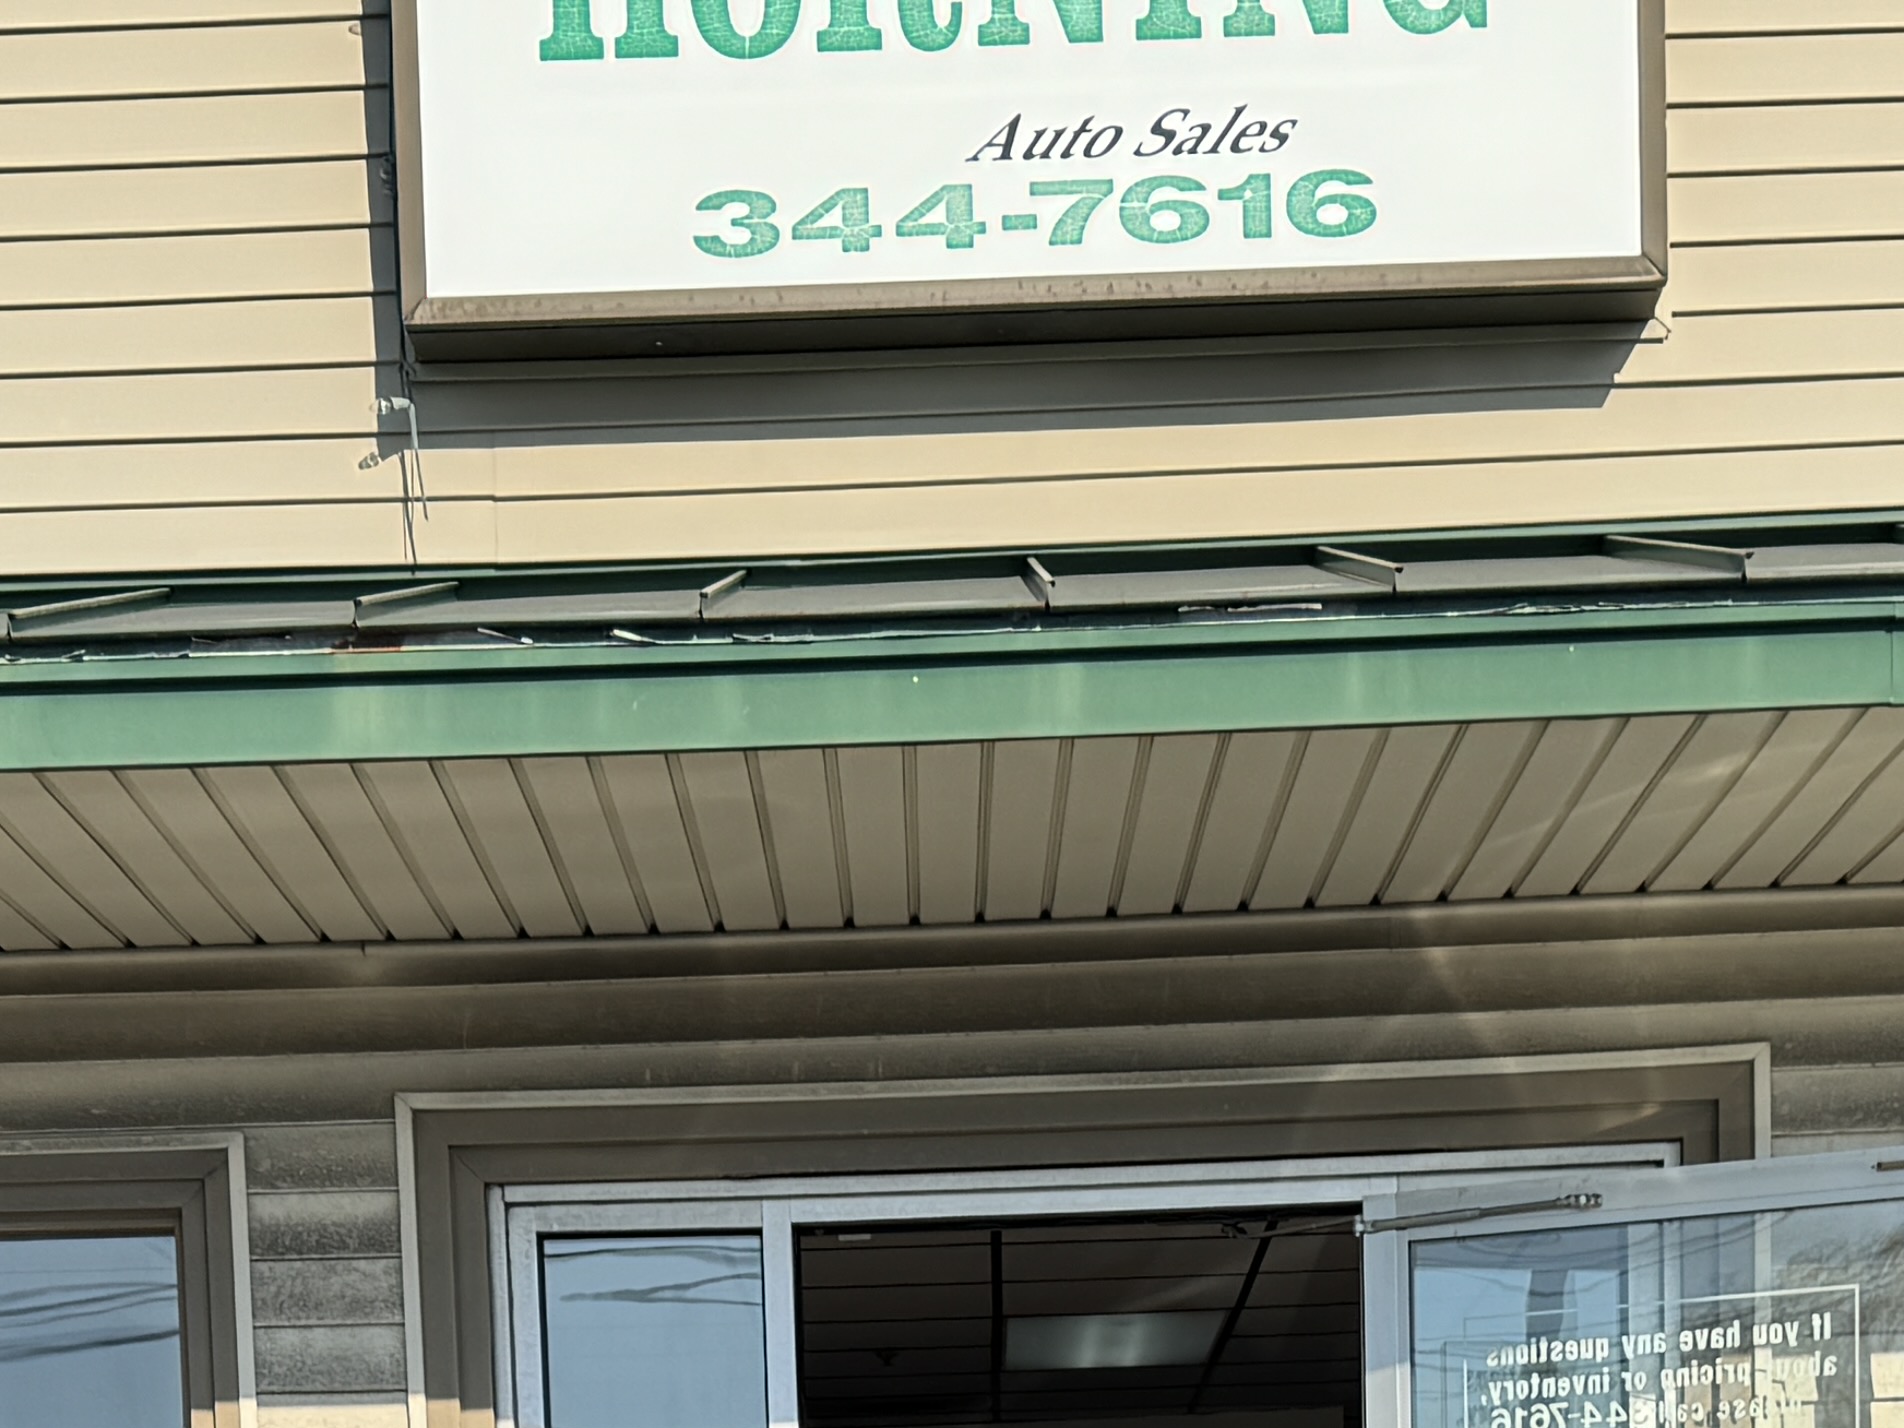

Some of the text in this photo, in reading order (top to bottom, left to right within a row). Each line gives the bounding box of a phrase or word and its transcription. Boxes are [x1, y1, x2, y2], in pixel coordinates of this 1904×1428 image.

[965, 103, 1300, 163] Auto Sales
[692, 168, 1377, 258] 344-7616
